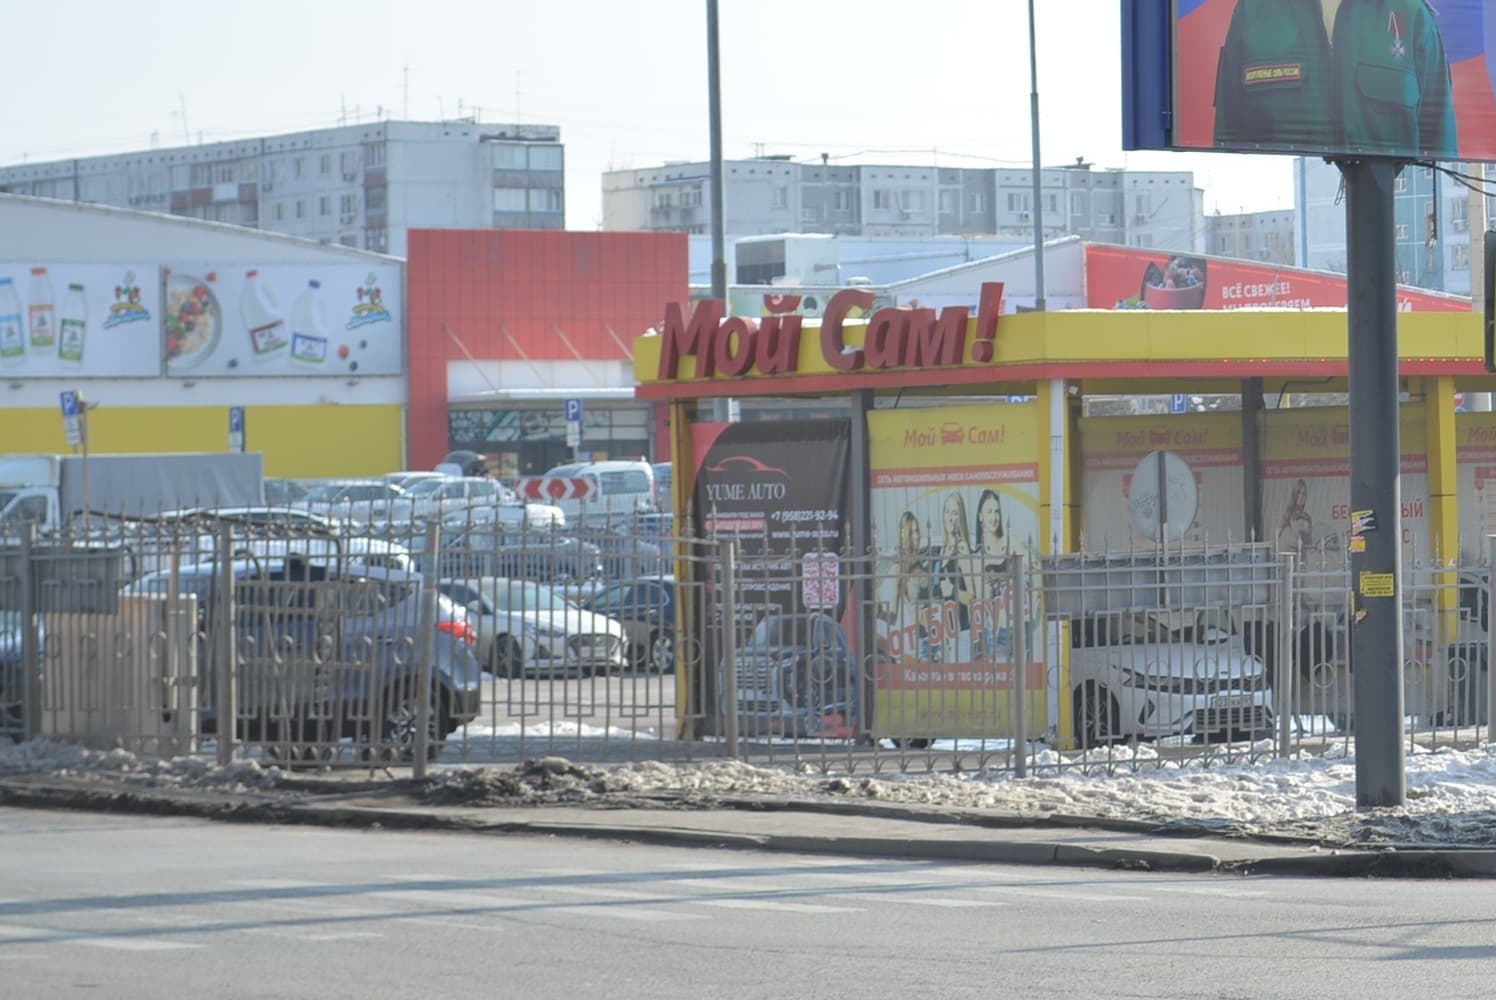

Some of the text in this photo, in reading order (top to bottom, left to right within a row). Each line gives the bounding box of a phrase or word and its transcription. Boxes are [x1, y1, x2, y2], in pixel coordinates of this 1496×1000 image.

[1222, 282, 1242, 299] ВСЁ
[658, 282, 1004, 380] Мой Сам!
[904, 424, 1006, 447] Мой Сам!
[706, 483, 785, 500] YUME AUTO
